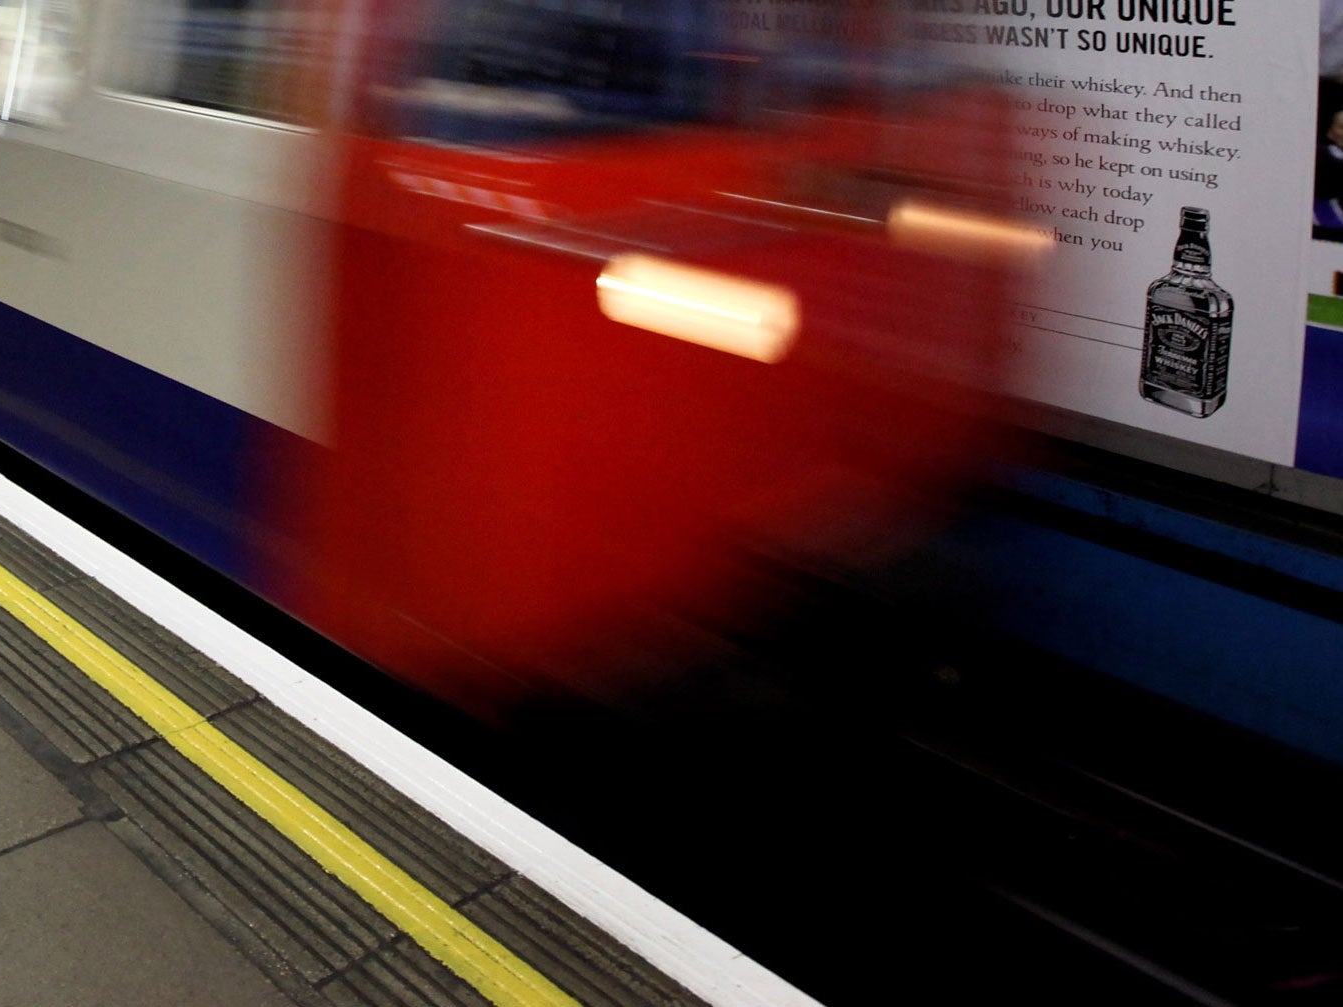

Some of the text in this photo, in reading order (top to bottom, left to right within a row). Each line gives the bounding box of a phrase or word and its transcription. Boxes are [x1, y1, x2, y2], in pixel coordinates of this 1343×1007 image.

[985, 26, 1070, 50] WASN'T
[1077, 30, 1107, 53] SO
[1116, 33, 1215, 59] UNIQUE.
[1028, 71, 1067, 90] their
[1070, 77, 1148, 98] whiskey.
[1152, 81, 1194, 101] And
[1199, 85, 1243, 104] then
[1014, 98, 1243, 133] to drop what they called
[1016, 125, 1243, 161] ways of making whiskey.
[1052, 155, 1071, 167] so
[1074, 151, 1095, 170] he
[1099, 155, 1136, 177] kept
[1140, 164, 1163, 178] on
[1168, 166, 1219, 190] using
[1038, 174, 1053, 190] is
[1057, 176, 1098, 199] why
[1102, 184, 1155, 207] today
[1061, 205, 1100, 224] each
[1104, 210, 1146, 233] drop
[1090, 234, 1124, 253] you
[1154, 355, 1199, 375] WHISKEY
